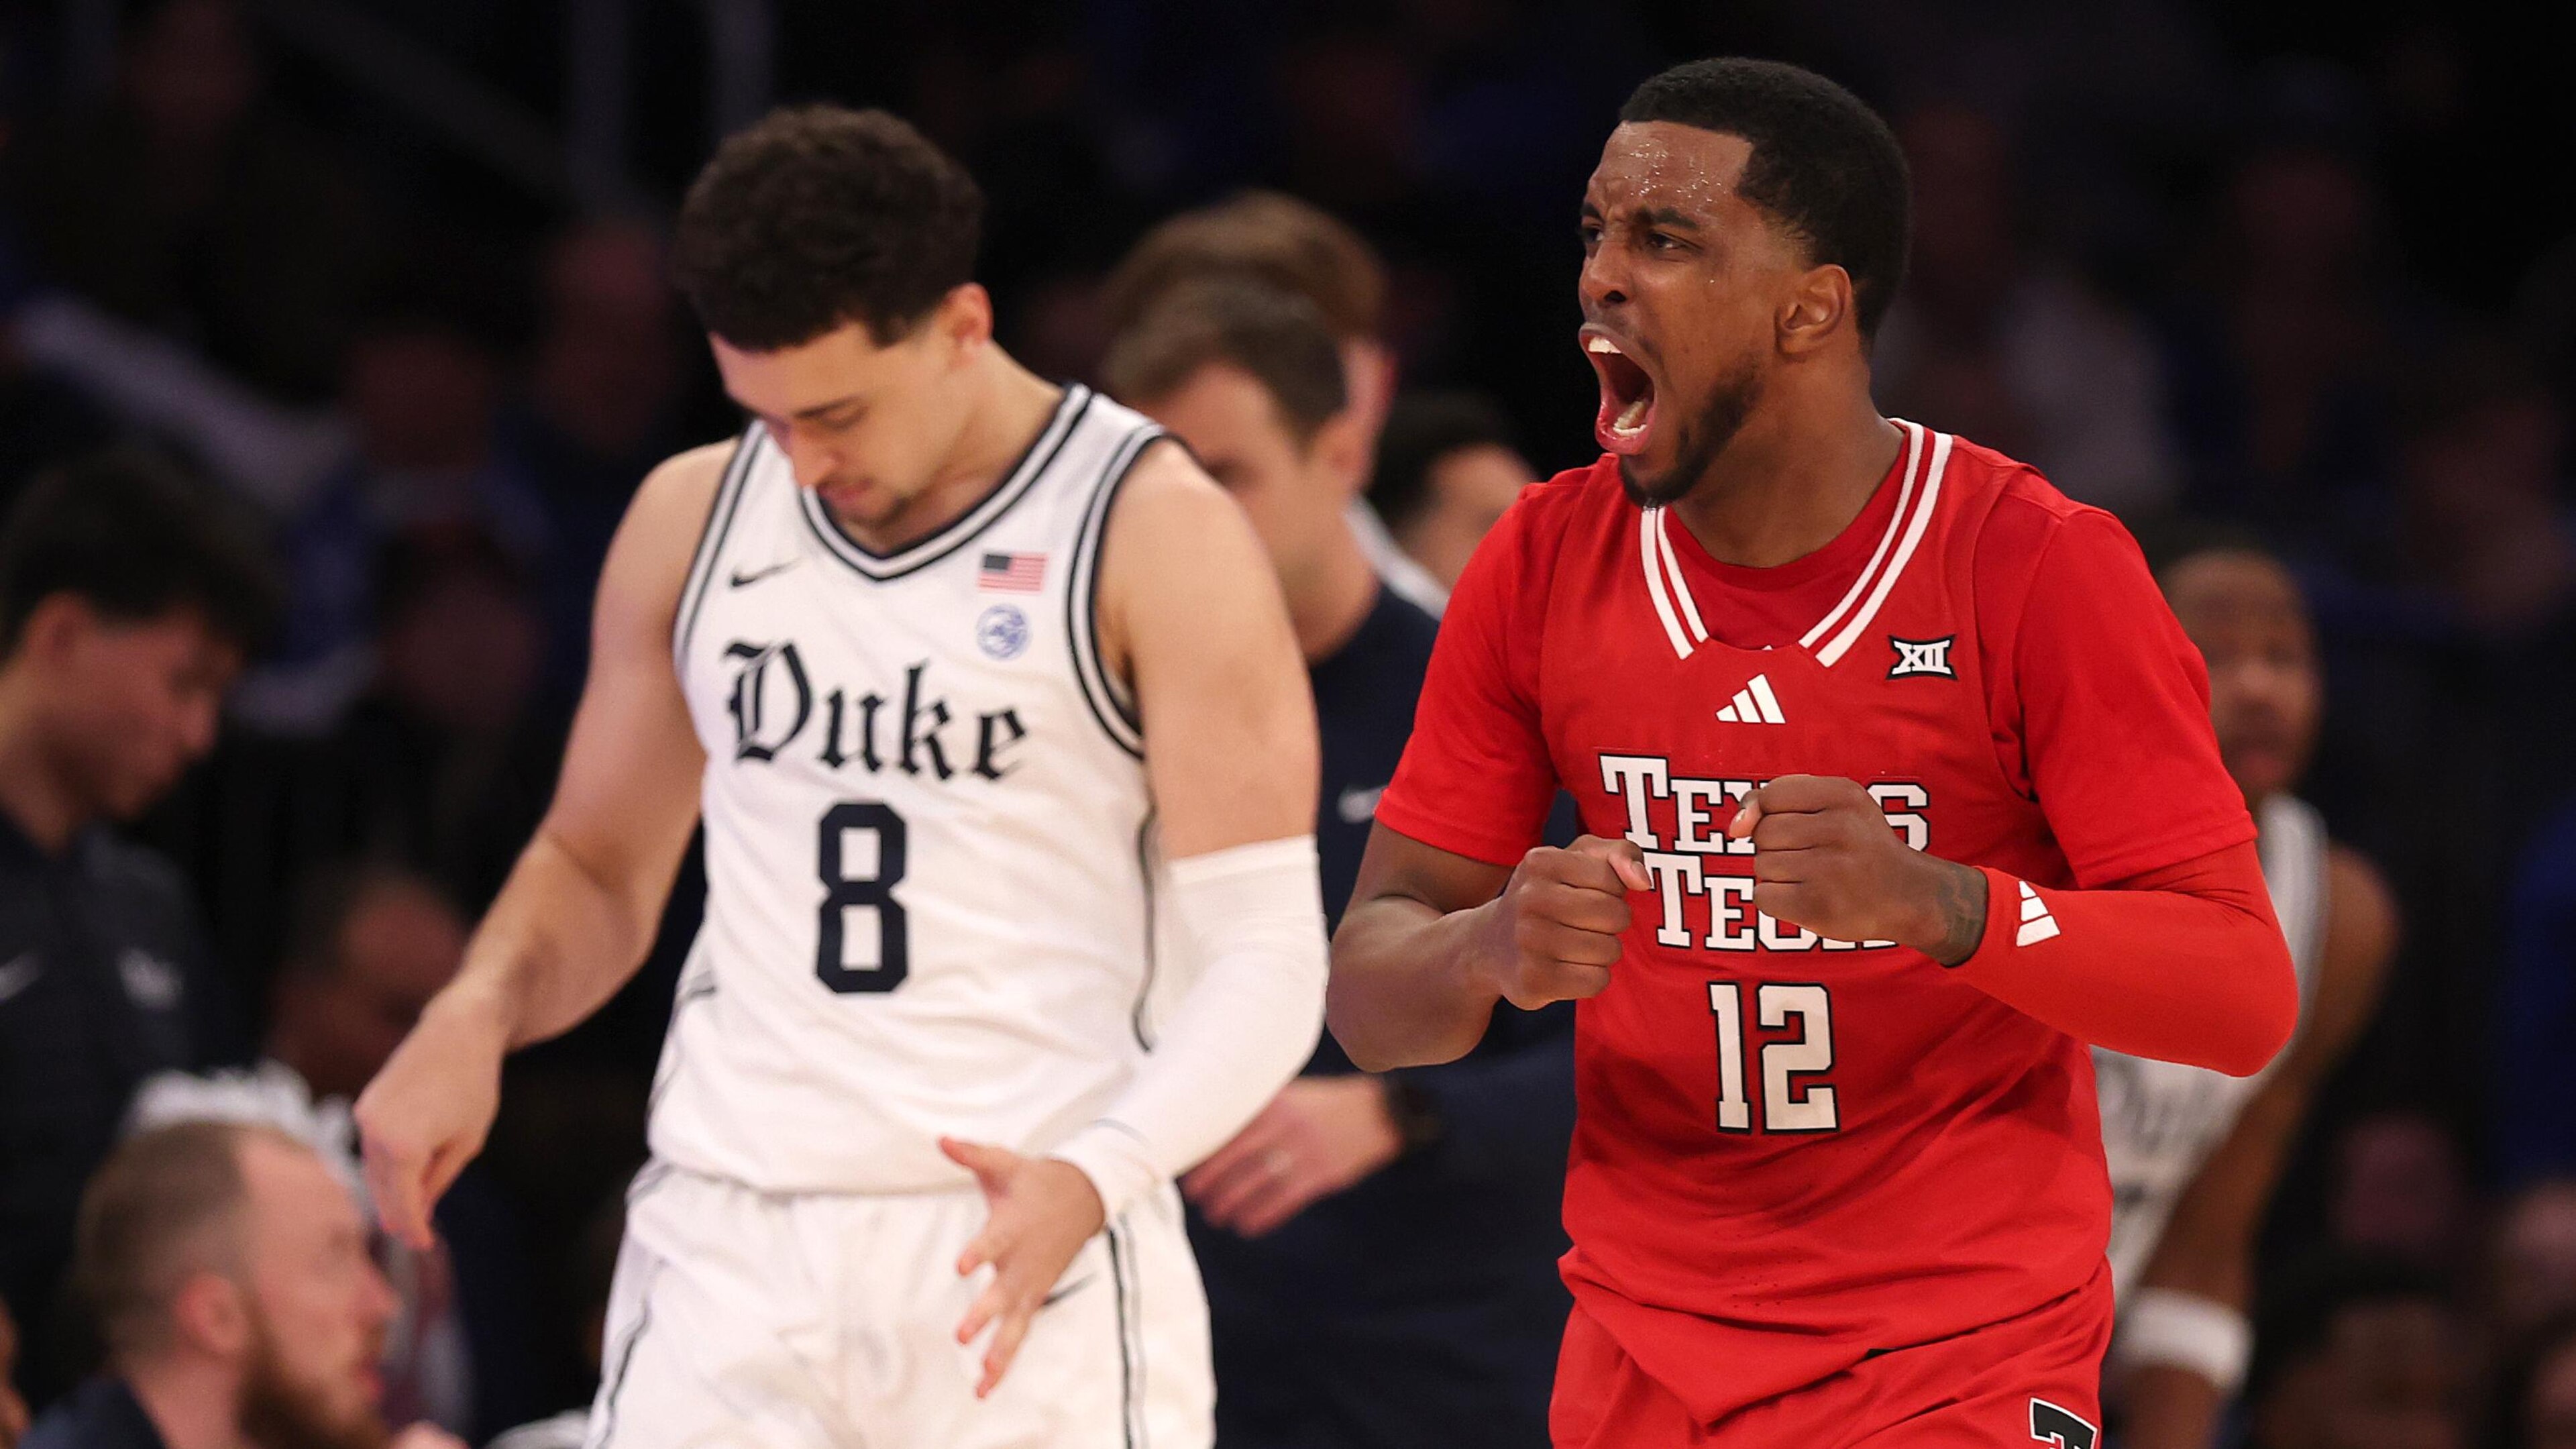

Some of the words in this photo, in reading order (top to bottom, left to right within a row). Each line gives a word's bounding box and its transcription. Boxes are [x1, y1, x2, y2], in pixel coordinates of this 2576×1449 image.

[723, 638, 1026, 780] Duke
[1888, 635, 1957, 680] XII
[1599, 753, 1931, 857] TES
[816, 801, 908, 993] 8
[1643, 851, 1898, 953] TE
[1707, 981, 1839, 1134] 12
